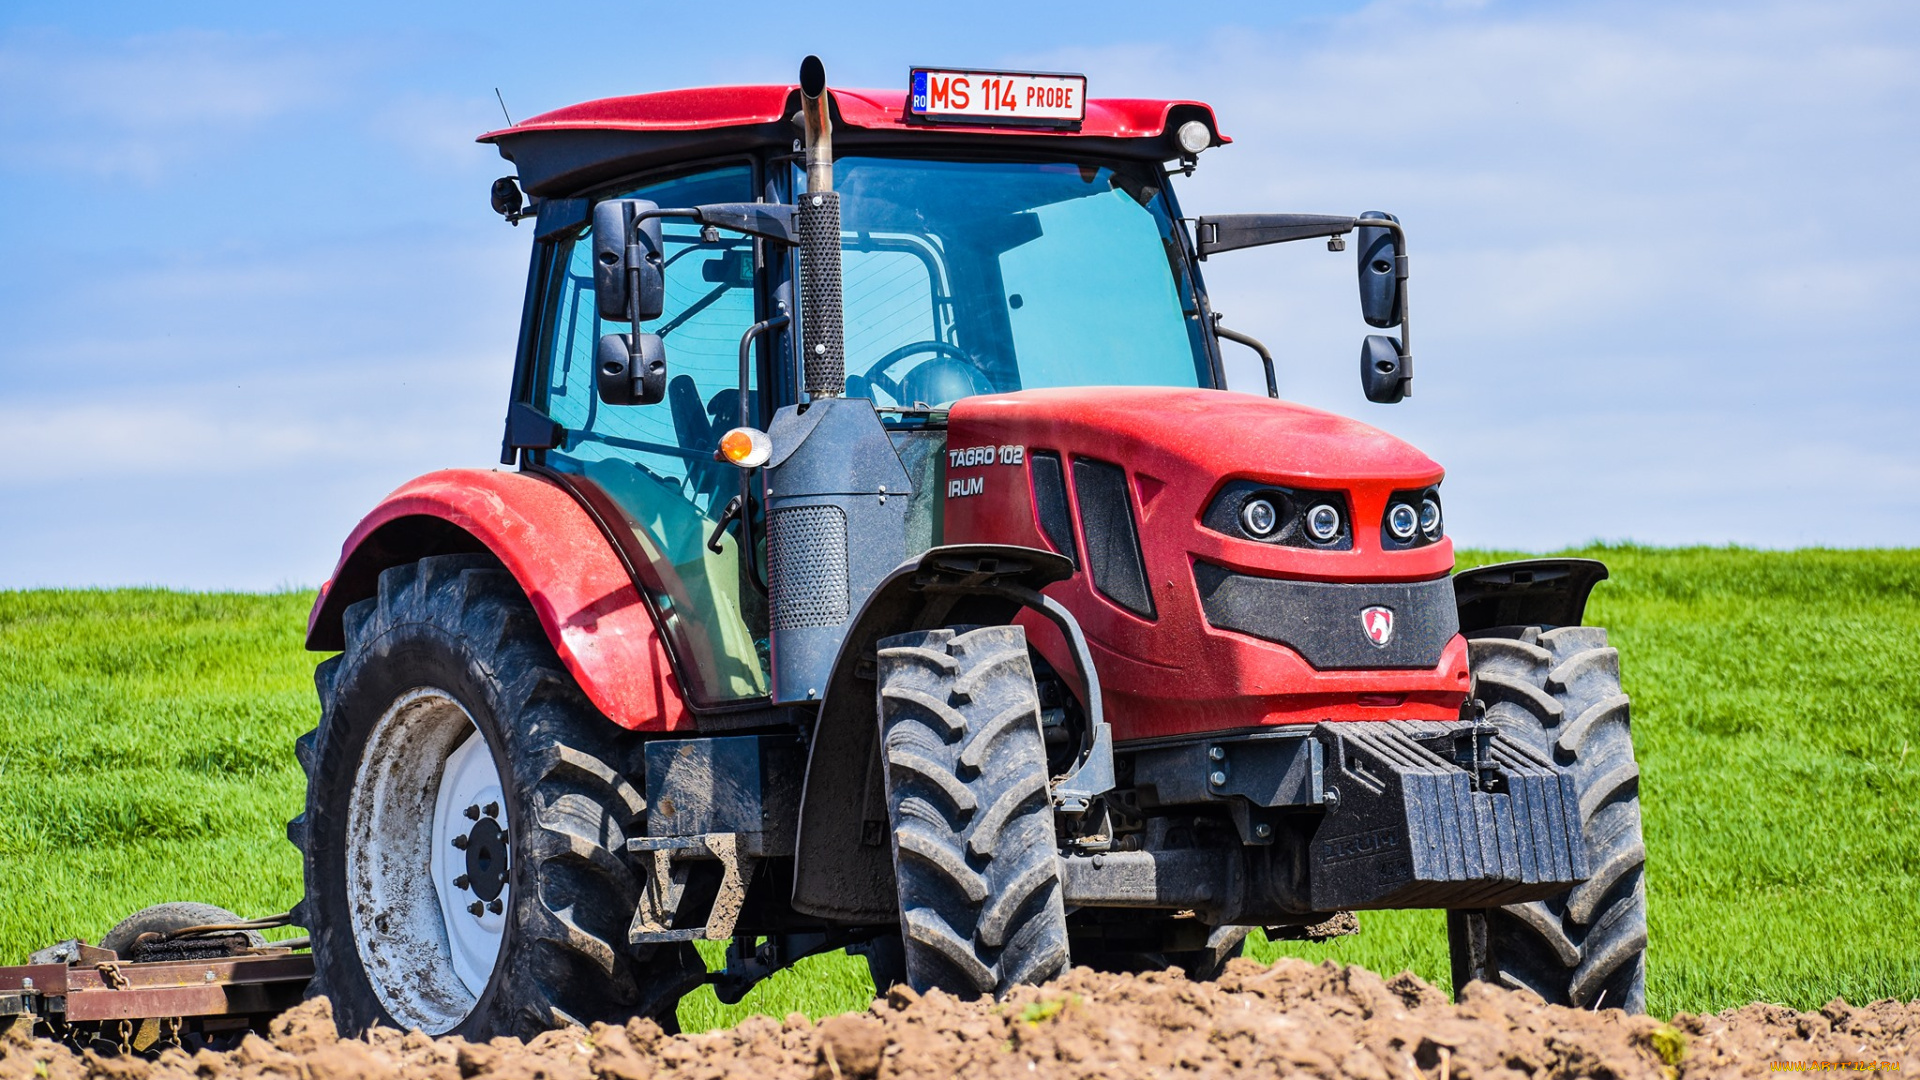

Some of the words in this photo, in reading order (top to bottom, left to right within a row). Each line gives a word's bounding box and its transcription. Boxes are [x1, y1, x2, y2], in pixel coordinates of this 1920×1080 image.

[913, 94, 927, 108] RO
[930, 76, 970, 110] MS
[981, 78, 1017, 112] 114
[1026, 86, 1074, 109] PROBE
[949, 445, 996, 468] TAGRO
[998, 444, 1025, 465] 102
[948, 476, 984, 498] IRUM
